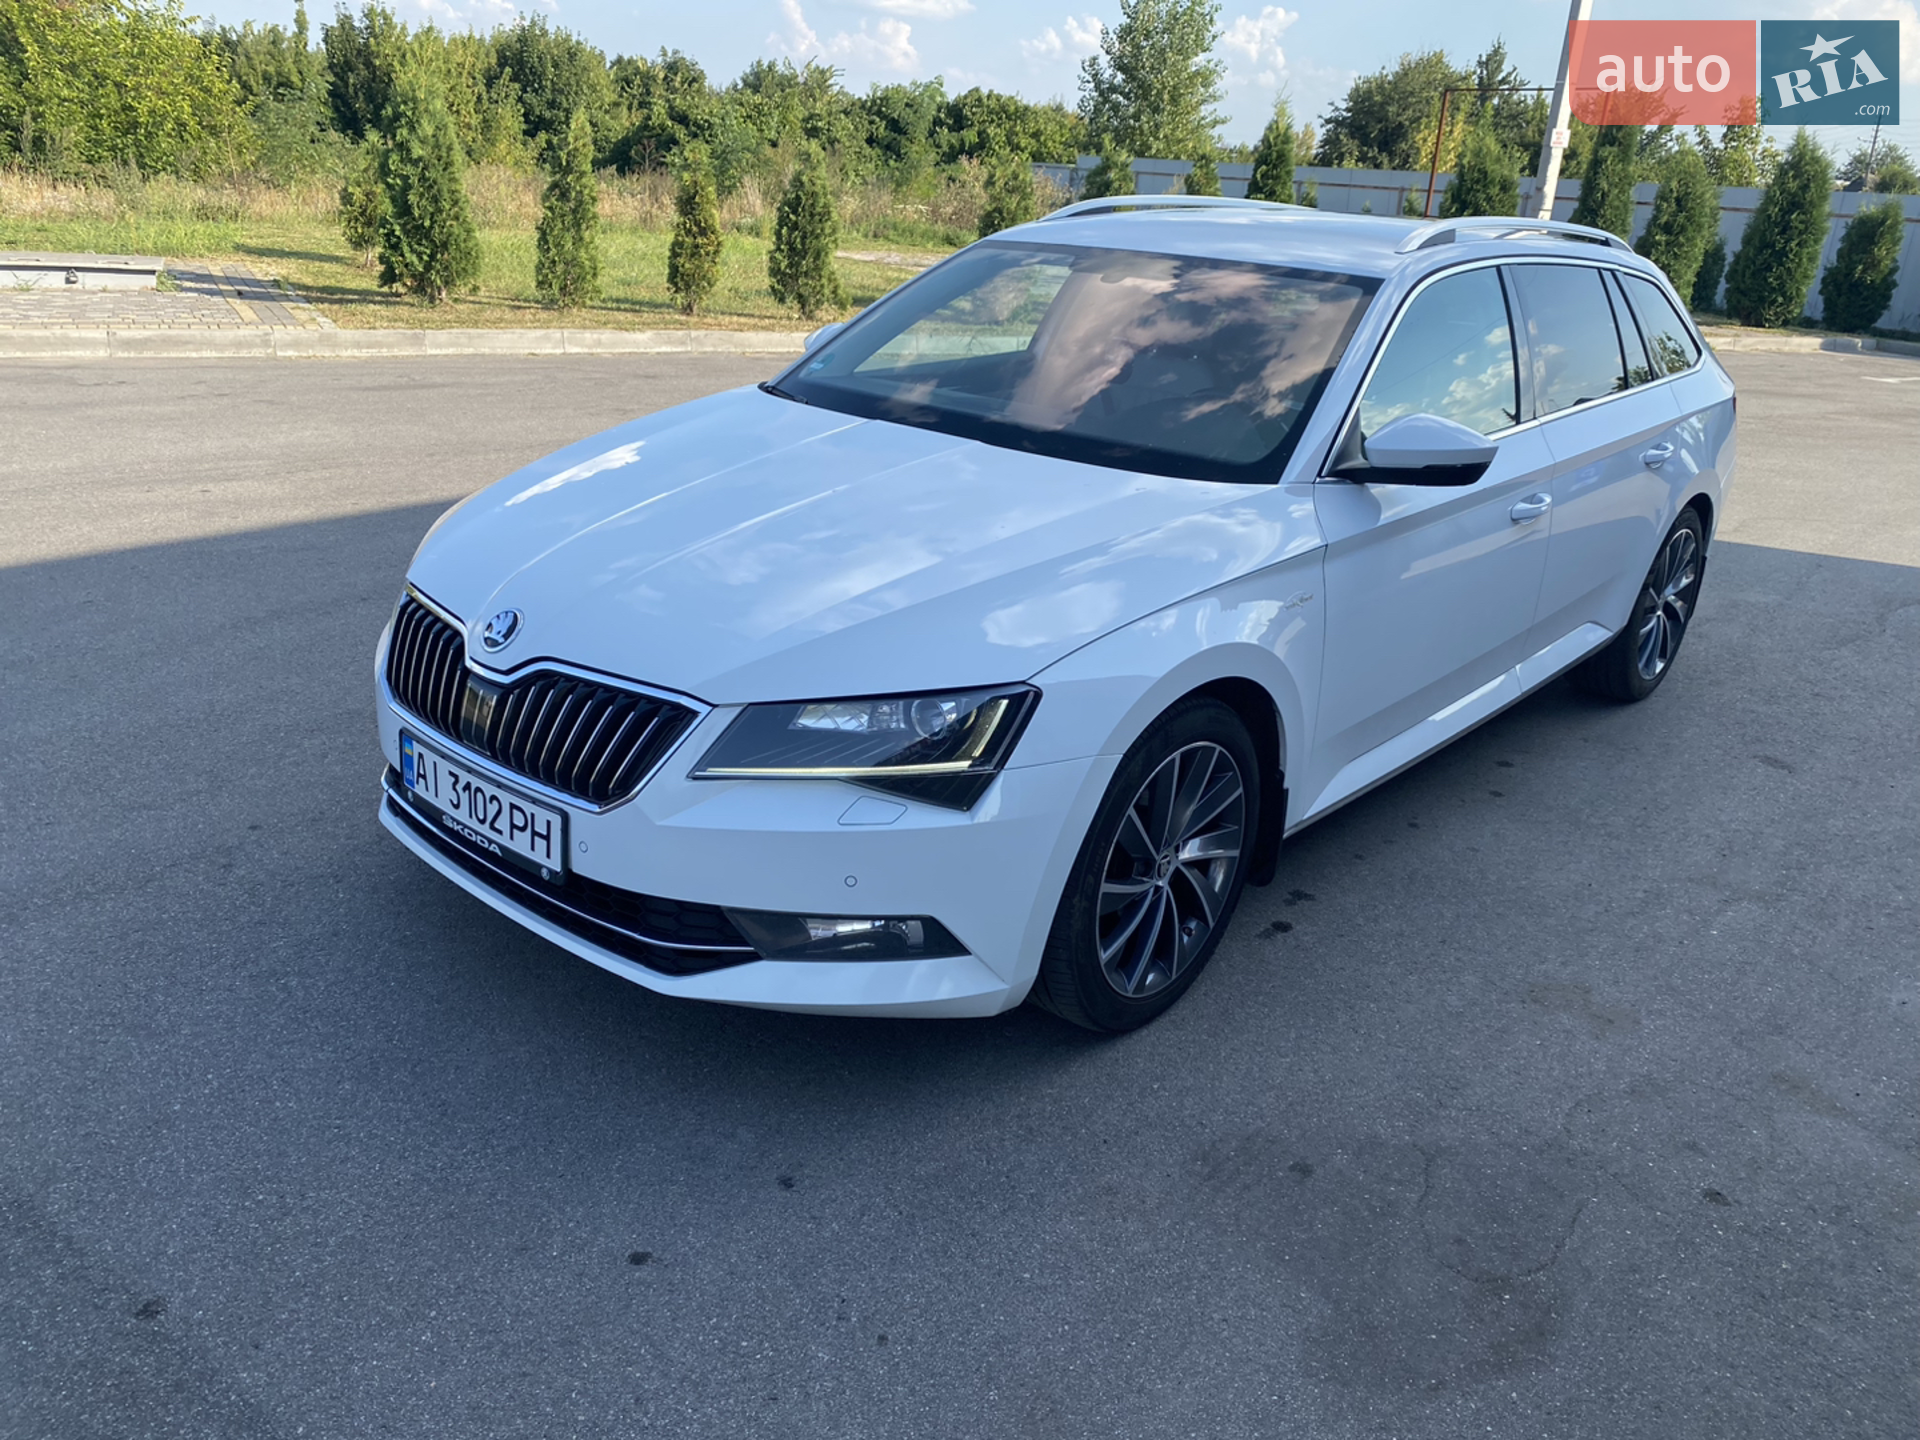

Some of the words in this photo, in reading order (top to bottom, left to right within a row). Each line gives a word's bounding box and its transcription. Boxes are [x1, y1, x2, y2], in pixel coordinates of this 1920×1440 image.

[416, 751, 438, 799] AI
[448, 770, 504, 837] 3102
[509, 801, 552, 860] PH
